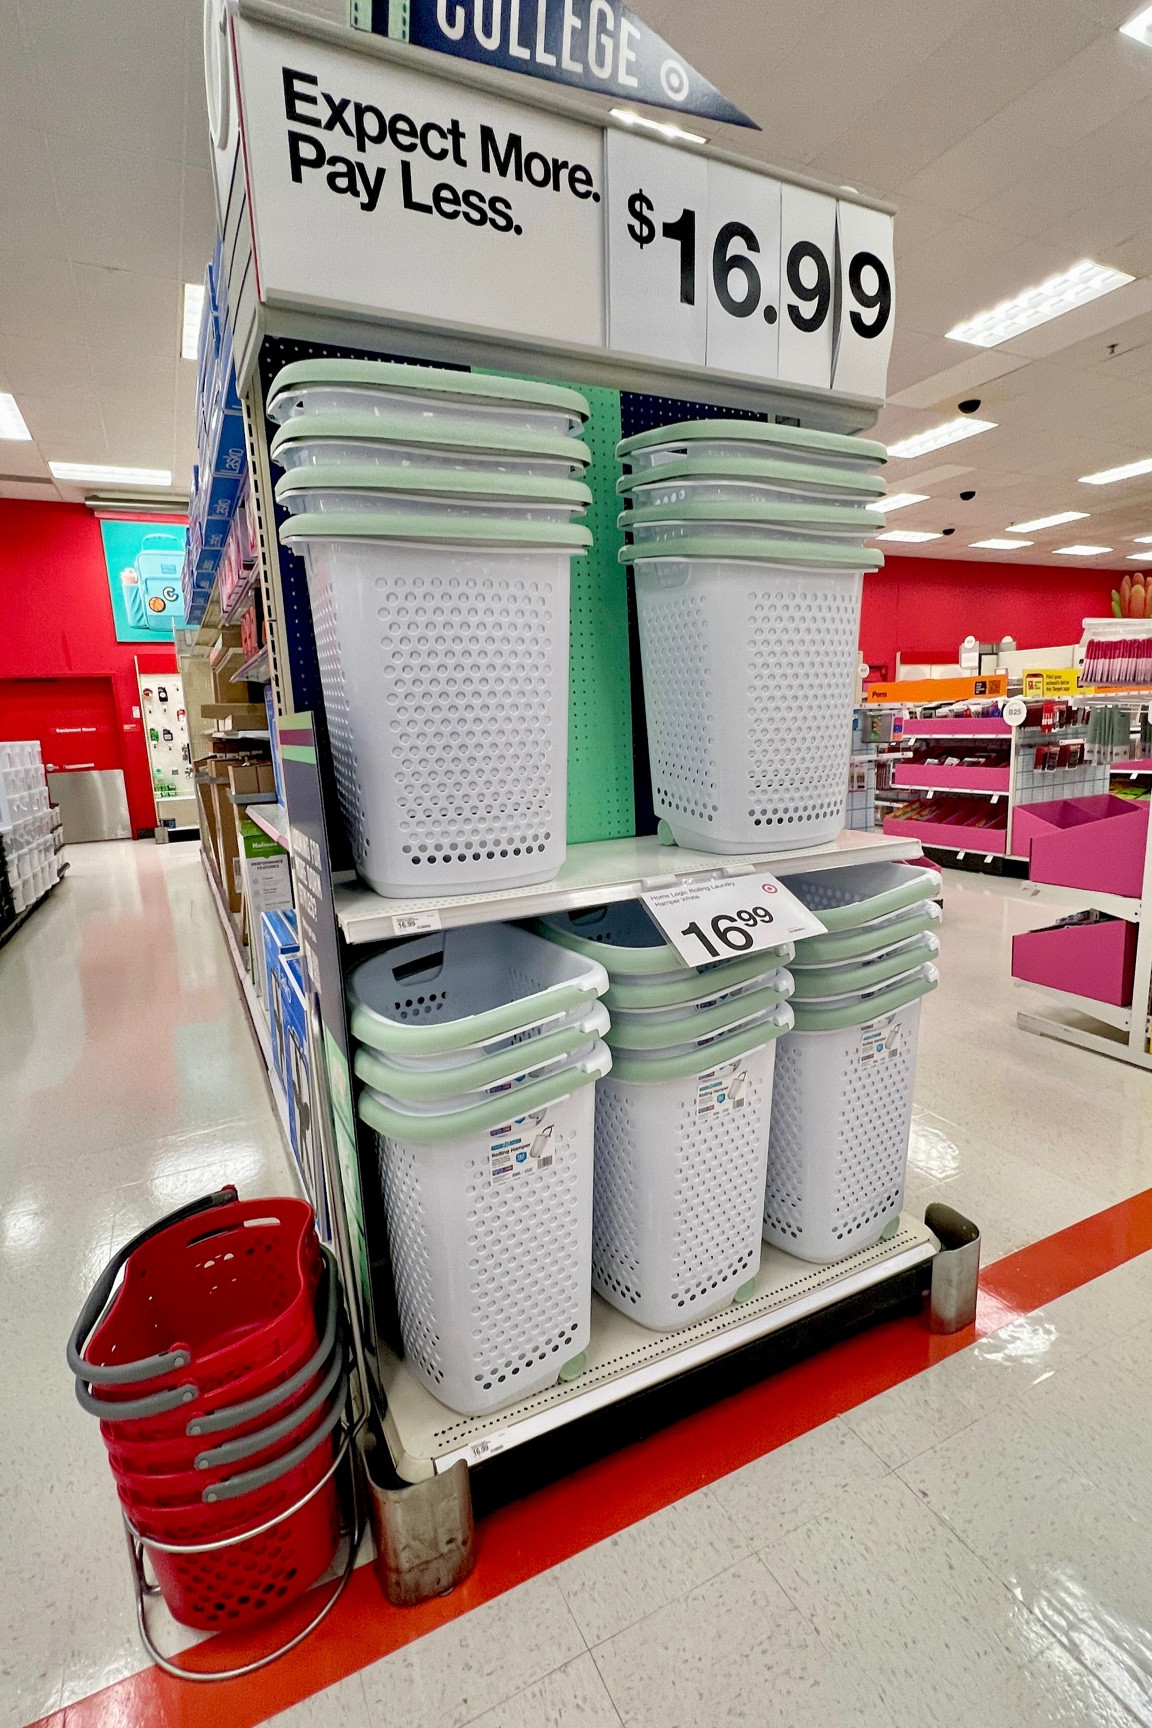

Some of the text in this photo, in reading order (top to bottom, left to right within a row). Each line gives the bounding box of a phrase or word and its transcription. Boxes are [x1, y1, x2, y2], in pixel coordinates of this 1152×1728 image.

[436, 0, 641, 88] COLLEGE
[281, 66, 601, 203] Expect More.
[287, 129, 523, 236] Pay Less.
[626, 188, 891, 339] $16.99
[649, 882, 736, 901] Home Logic Rolling Laundry
[654, 898, 680, 907] Hamper
